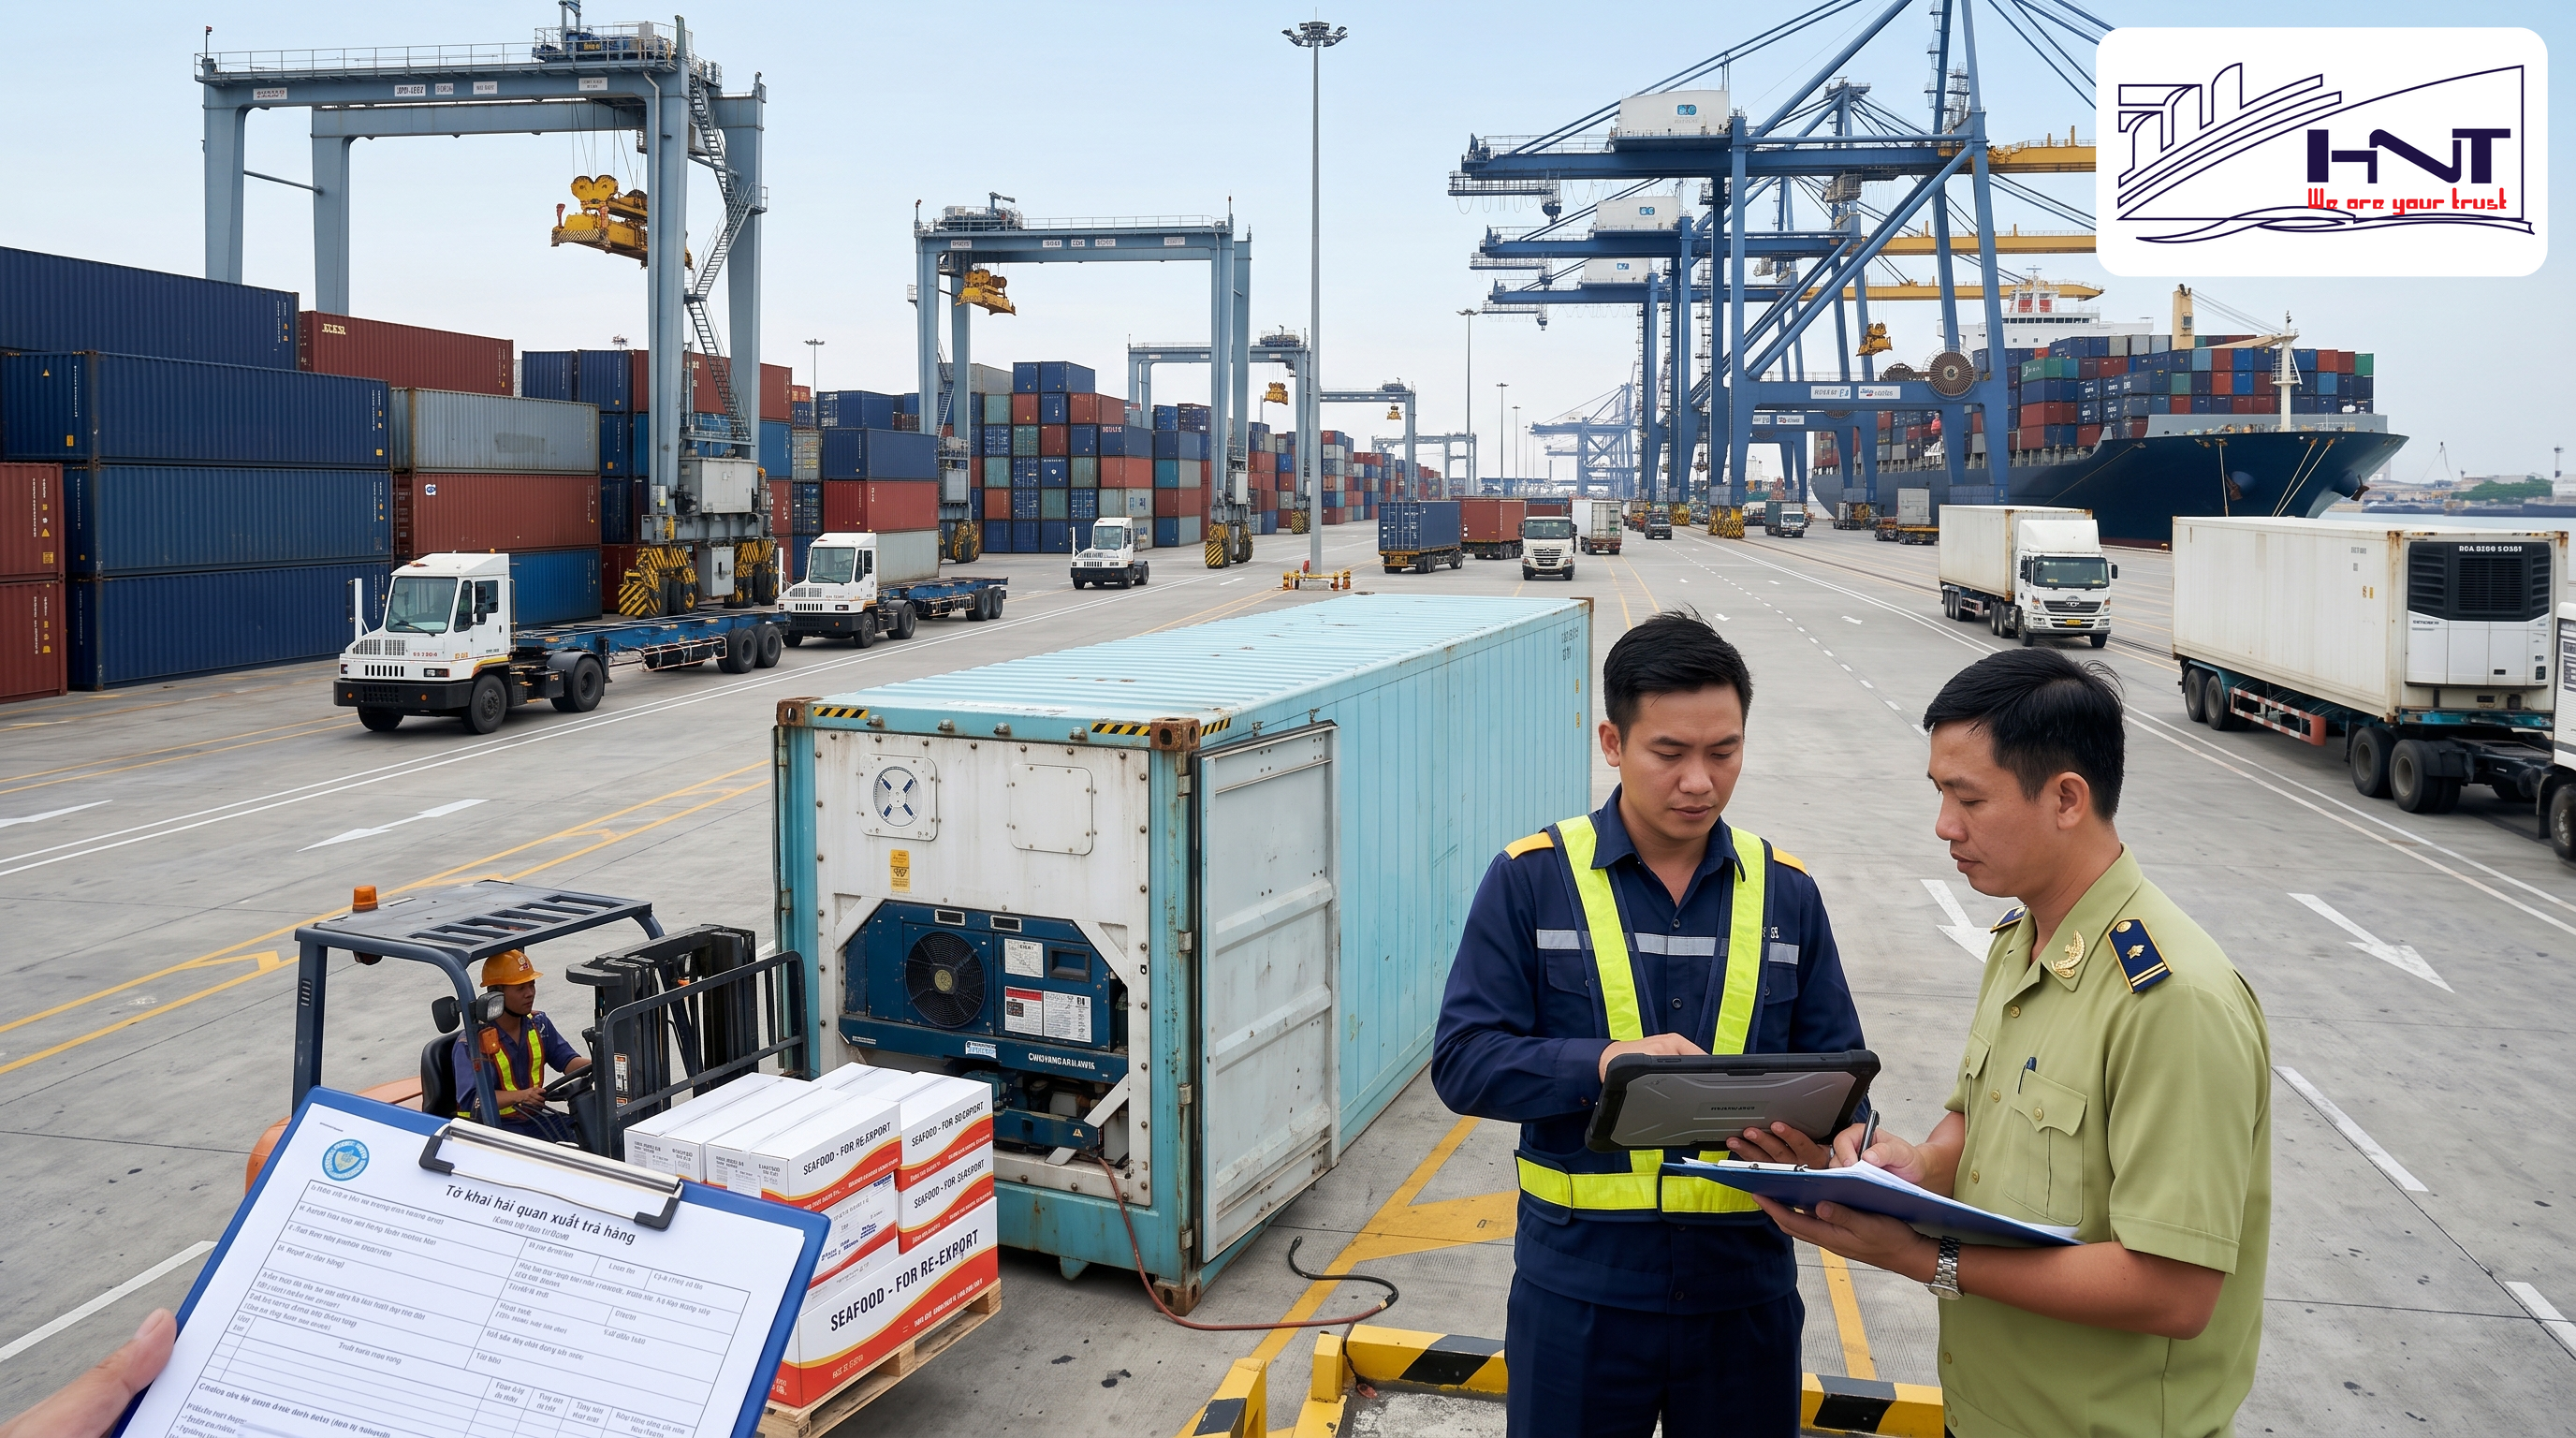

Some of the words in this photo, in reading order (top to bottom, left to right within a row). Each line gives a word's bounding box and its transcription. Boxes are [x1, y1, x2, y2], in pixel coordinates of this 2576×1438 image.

[911, 1125, 938, 1147] SEAFOOD
[942, 1117, 954, 1131] FOR
[803, 1152, 835, 1176] SEAFOOD
[840, 1141, 855, 1156] FOR
[463, 1189, 493, 1207] khai
[517, 1205, 549, 1221] quan
[914, 1185, 940, 1209] SEAFOOD
[944, 1176, 956, 1191] FOR
[830, 1286, 886, 1332] SEAFOOD
[895, 1267, 918, 1293] FOR
